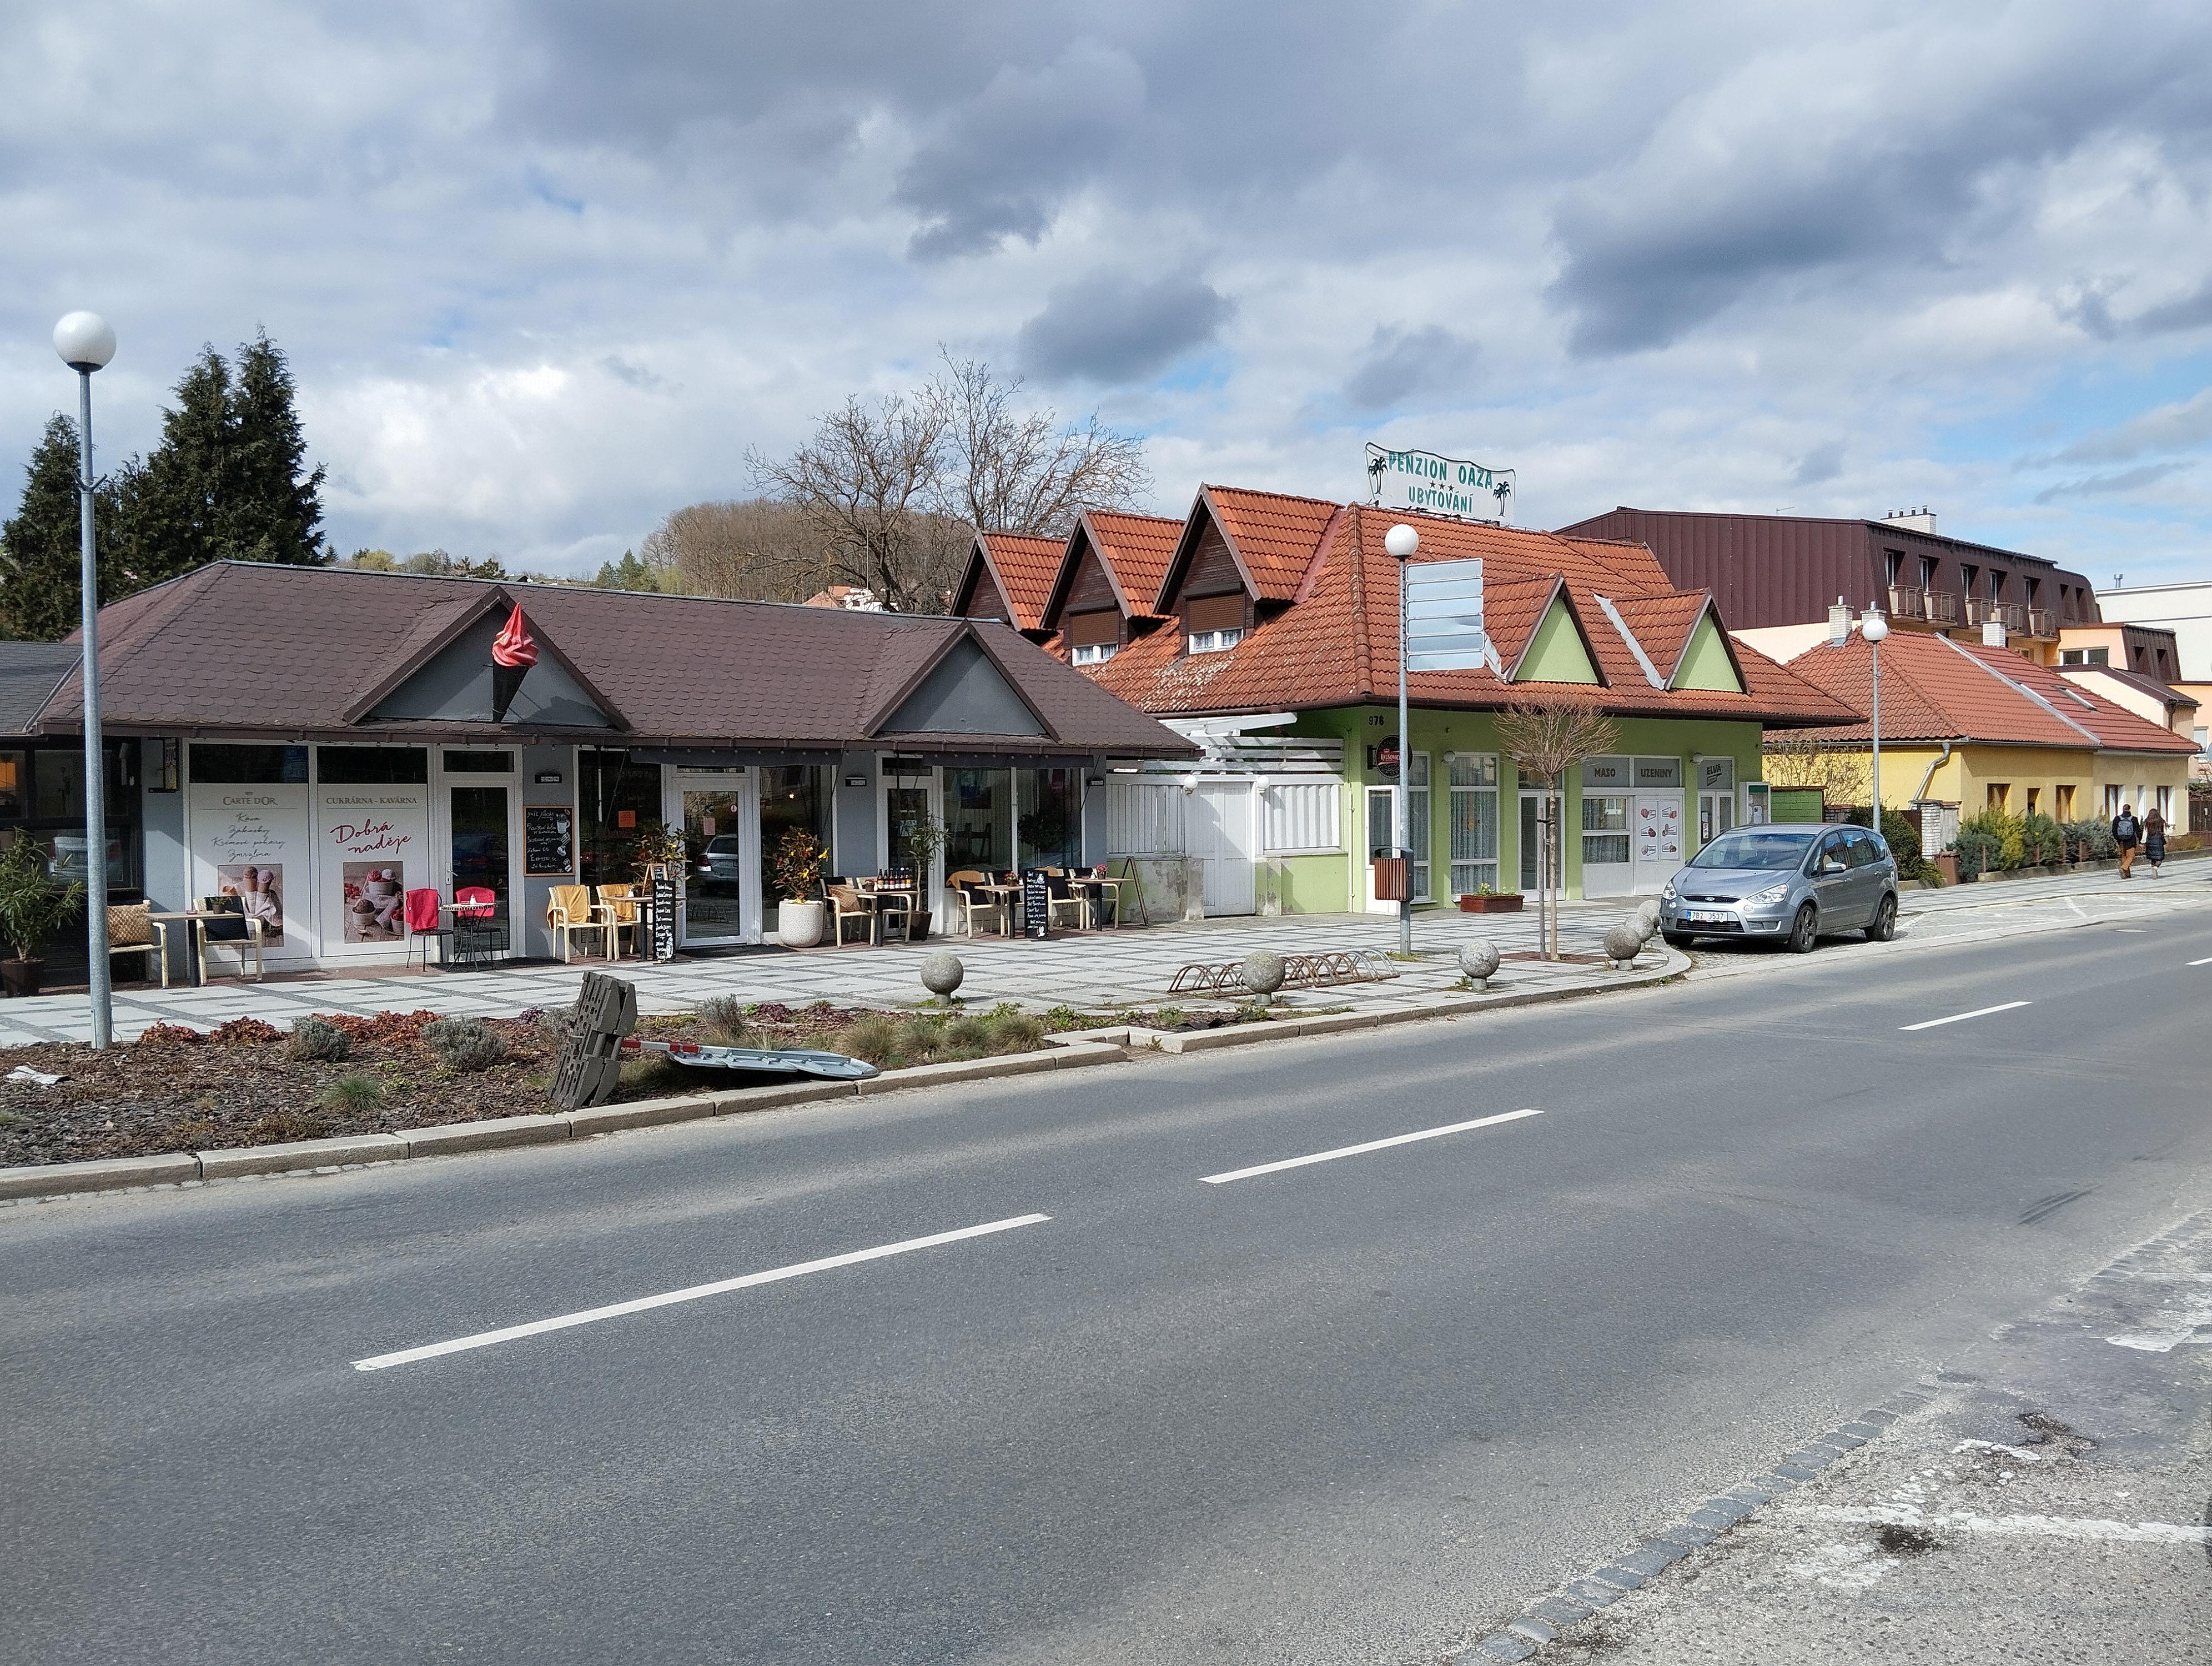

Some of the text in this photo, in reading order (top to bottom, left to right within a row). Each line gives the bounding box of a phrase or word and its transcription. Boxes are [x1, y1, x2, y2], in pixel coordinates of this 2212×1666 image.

[1389, 452, 1492, 489] PENZION OAZA
[1409, 485, 1473, 513] UBYTOVÁNÍ
[1594, 768, 1616, 777] MASO
[1641, 769, 1673, 778] UZENINY
[1706, 764, 1721, 775] ELVA
[223, 796, 252, 805] CARTE
[330, 819, 394, 844] Dobrá
[348, 834, 411, 854] naděje
